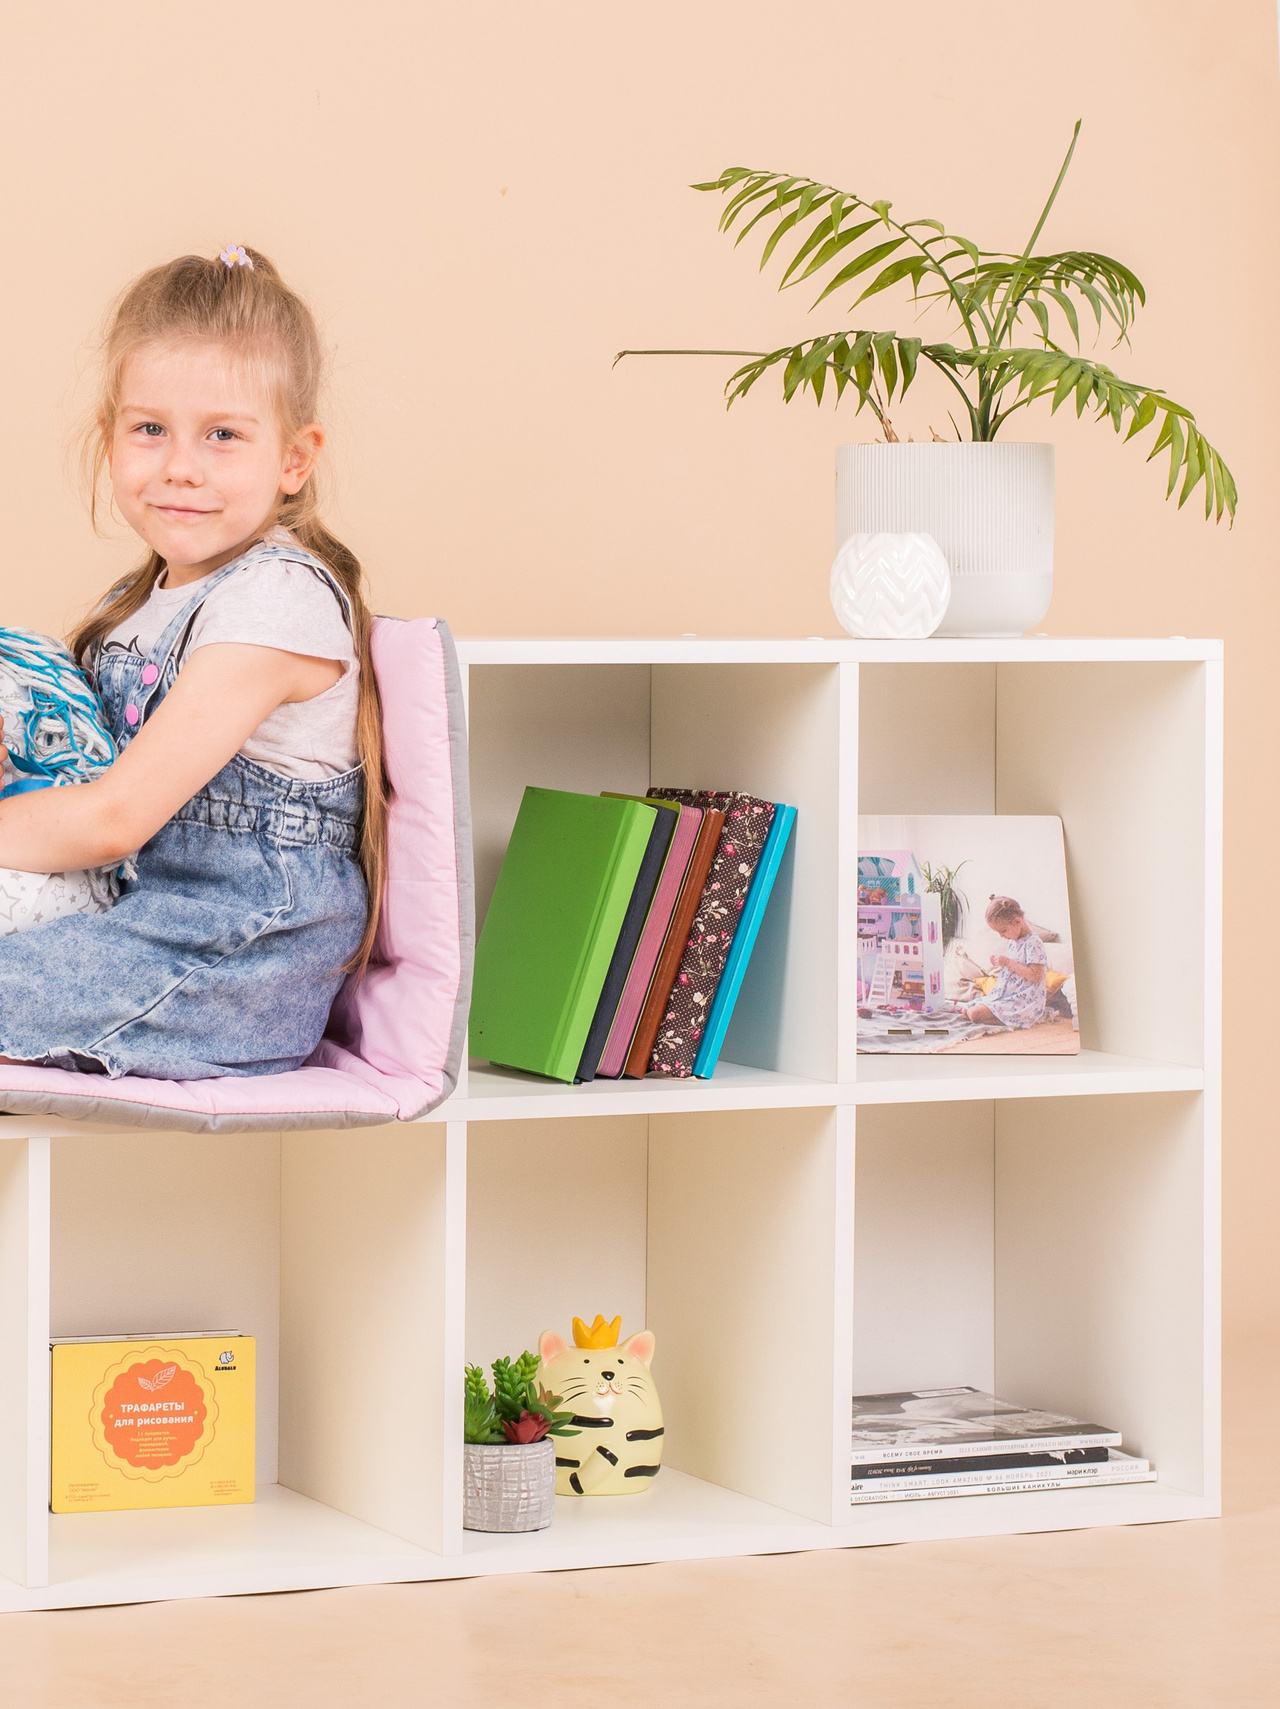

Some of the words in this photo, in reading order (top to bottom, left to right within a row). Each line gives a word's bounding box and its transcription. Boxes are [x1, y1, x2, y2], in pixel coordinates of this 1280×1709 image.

[120, 1401, 185, 1414] ТРАФАРЕТЫ
[114, 1418, 134, 1428] для
[137, 1415, 194, 1427] рисования
[952, 1476, 983, 1484] AMAZING
[986, 1484, 1020, 1492] БОЛЬШИЕ
[854, 1494, 888, 1502] DECORATION
